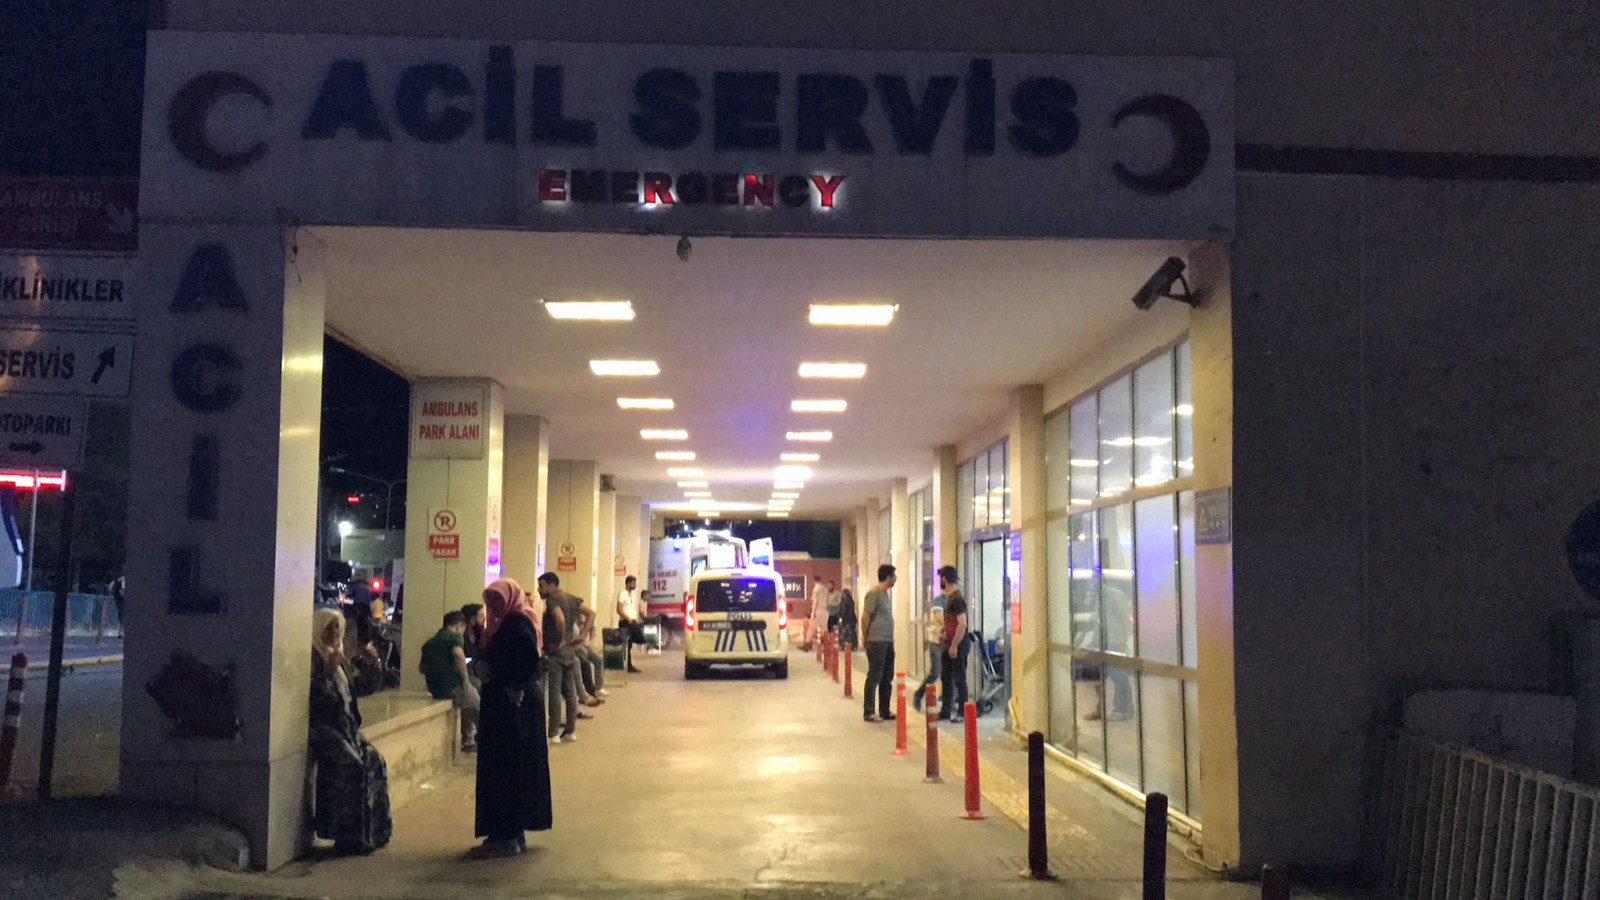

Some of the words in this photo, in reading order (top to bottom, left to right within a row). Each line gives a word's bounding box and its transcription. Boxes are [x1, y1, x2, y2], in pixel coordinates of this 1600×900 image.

[301, 45, 597, 147] ACİL
[629, 58, 1081, 158] SERVİS
[538, 168, 846, 208] EMERGENCY
[0, 271, 124, 302] KLİNİKLER
[422, 401, 478, 417] AMBULANS
[0, 413, 71, 436] TOPARKI
[420, 424, 445, 440] PARK
[449, 424, 480, 440] ALANI
[433, 536, 455, 545] PARK
[653, 579, 667, 592] 112
